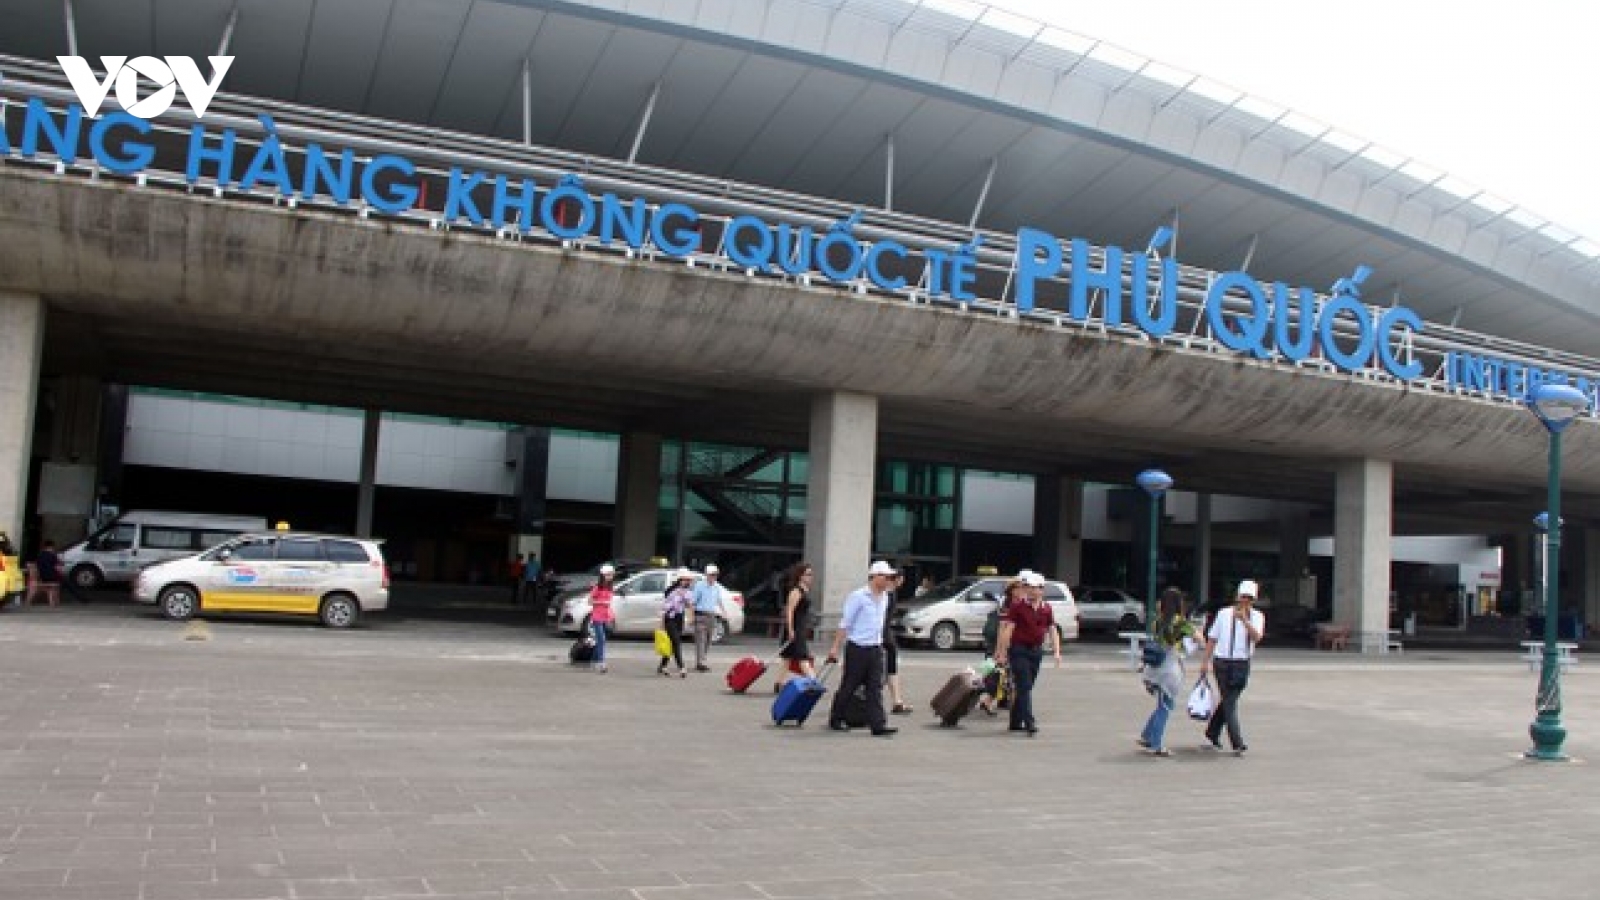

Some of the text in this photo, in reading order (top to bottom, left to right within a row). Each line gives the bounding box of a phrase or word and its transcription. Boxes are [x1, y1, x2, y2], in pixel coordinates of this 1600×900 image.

[0, 94, 1600, 417] NG HÀNG KHÔNG QUỐC TẾ PHÚ QUỐC INTER
